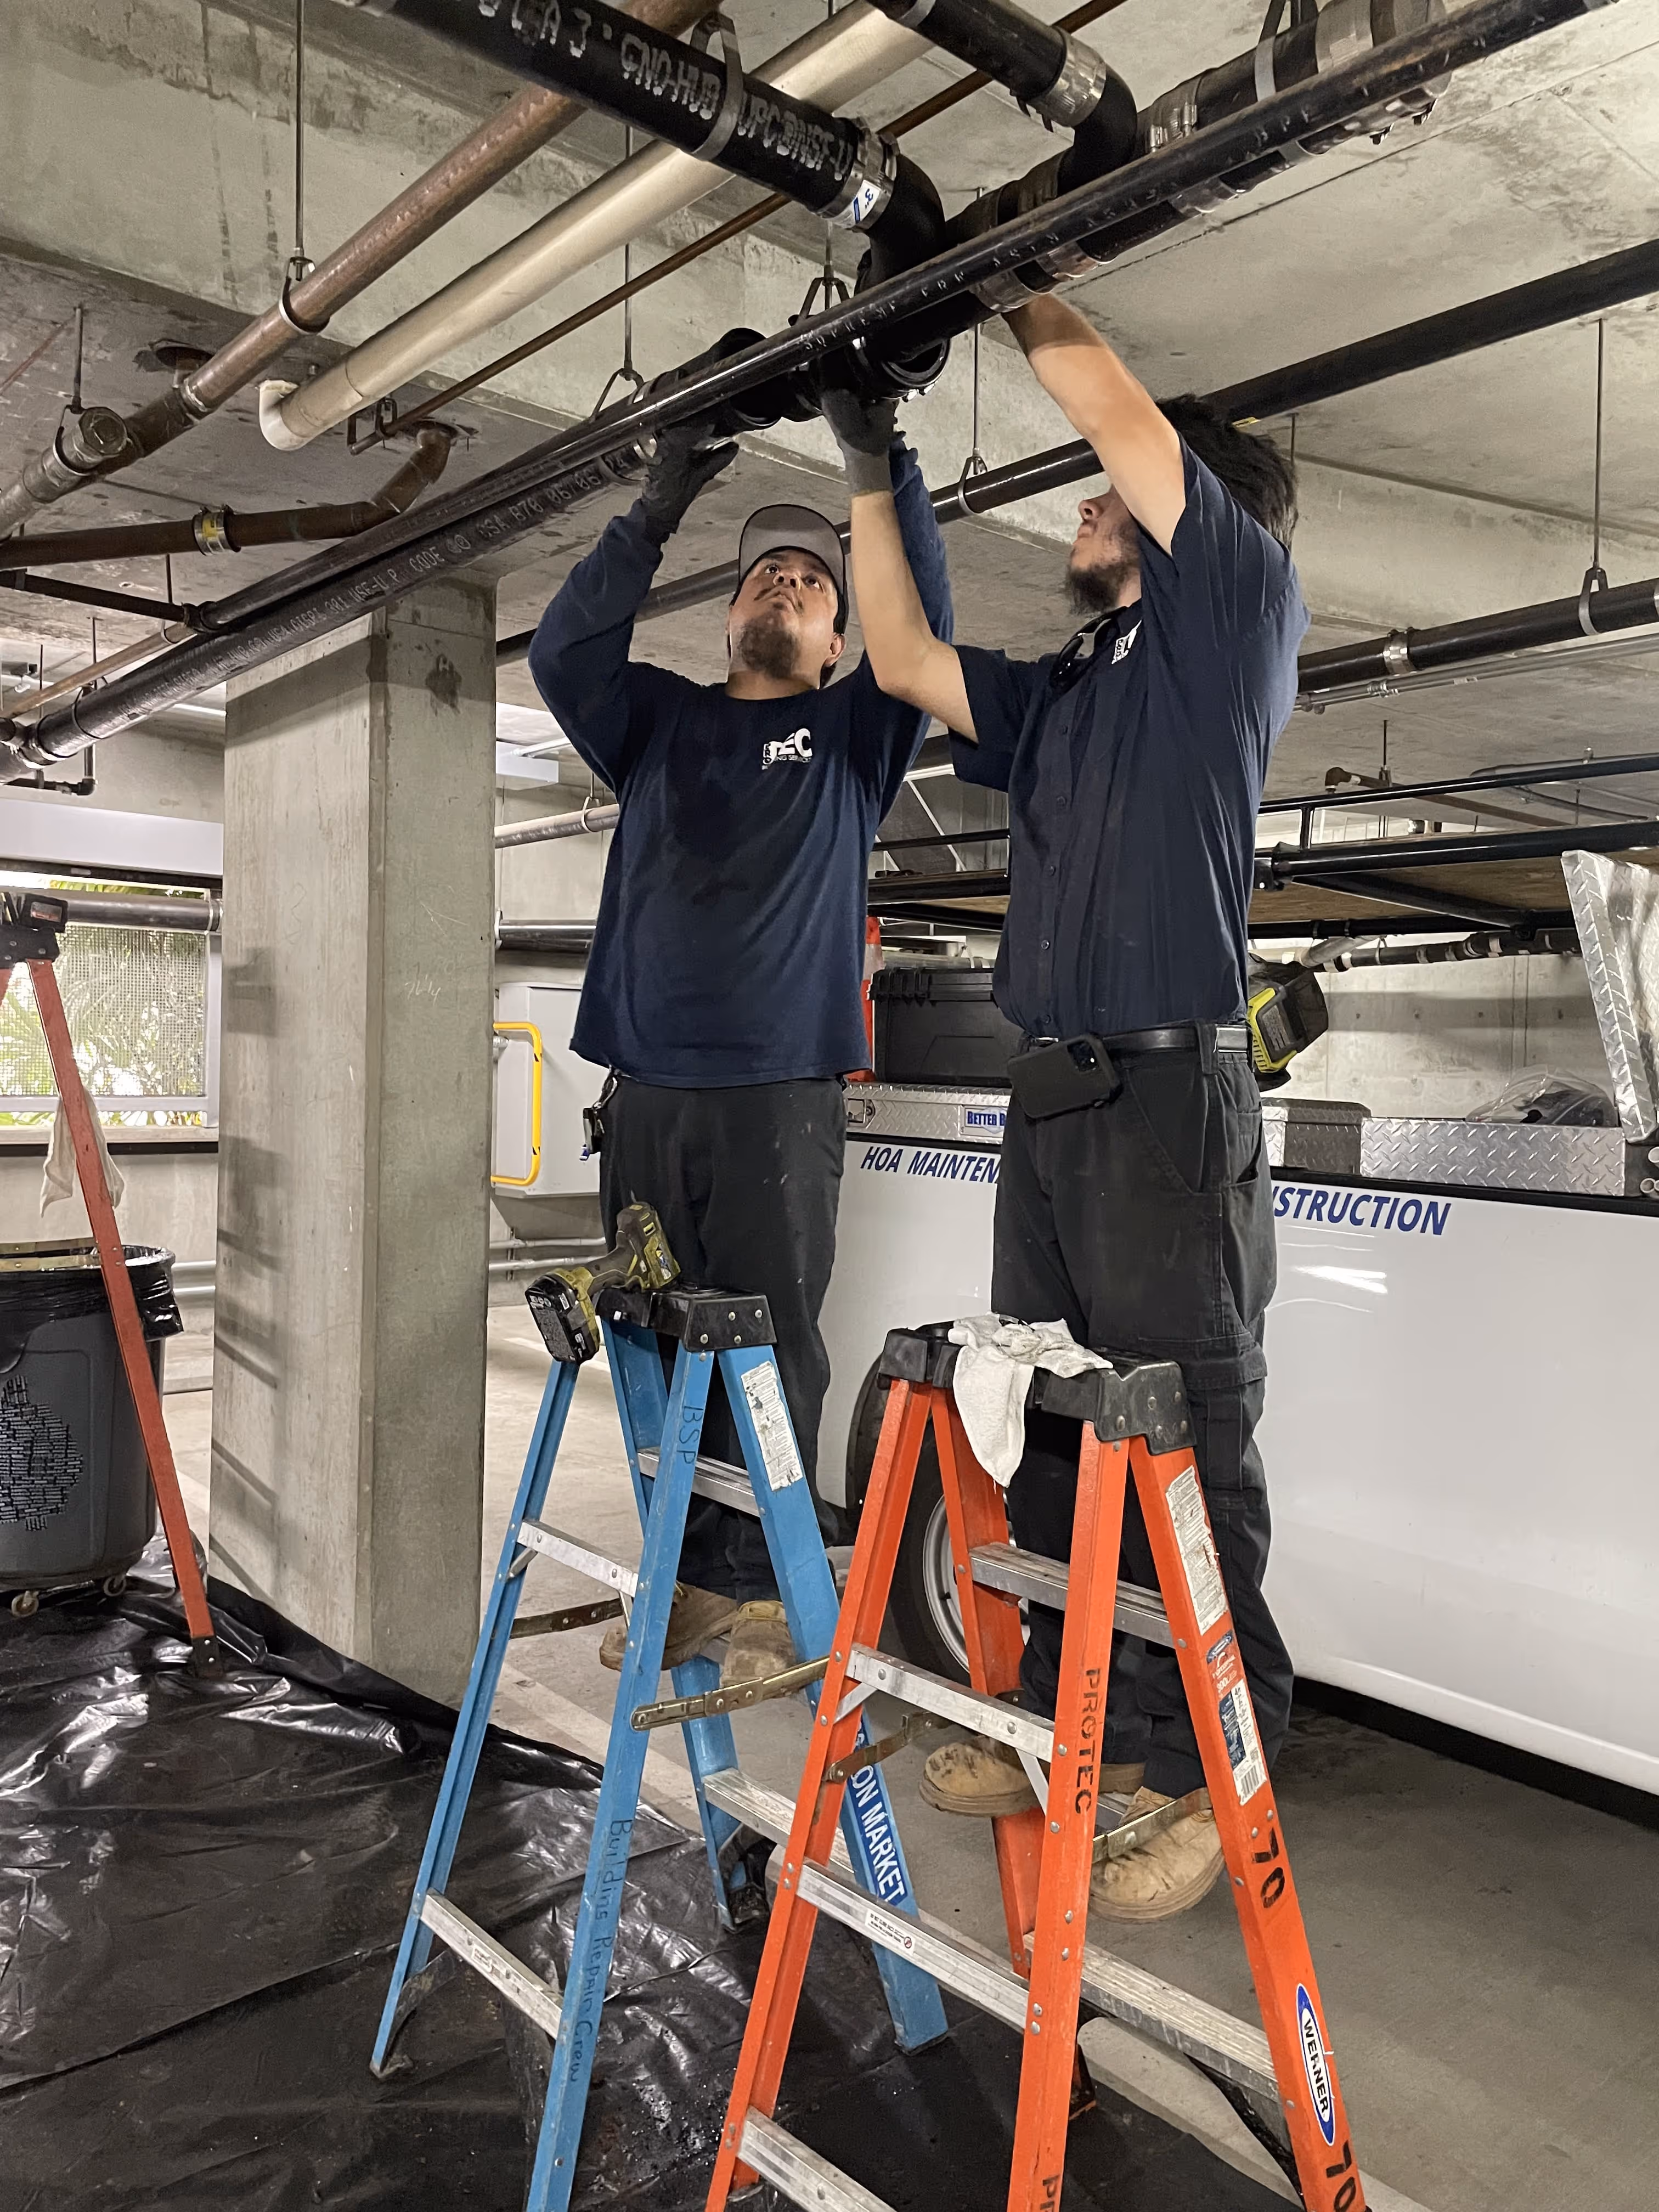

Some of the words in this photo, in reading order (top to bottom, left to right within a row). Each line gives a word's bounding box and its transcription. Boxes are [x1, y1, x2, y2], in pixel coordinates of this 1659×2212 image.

[409, 546, 445, 573] CODE
[967, 1111, 997, 1126] BETTER
[860, 1146, 904, 1173] HOA
[907, 1150, 1001, 1184] MAINTEN
[1273, 1186, 1452, 1235] STRUCTION
[676, 1406, 703, 1464] BSP
[1075, 1668, 1101, 1814] PROTEC
[595, 1819, 633, 1920] Building
[861, 1802, 906, 1903] MARKET
[1252, 1826, 1285, 1909] 70
[1304, 2018, 1329, 2113] WERNER
[1325, 2140, 1357, 2212] 70
